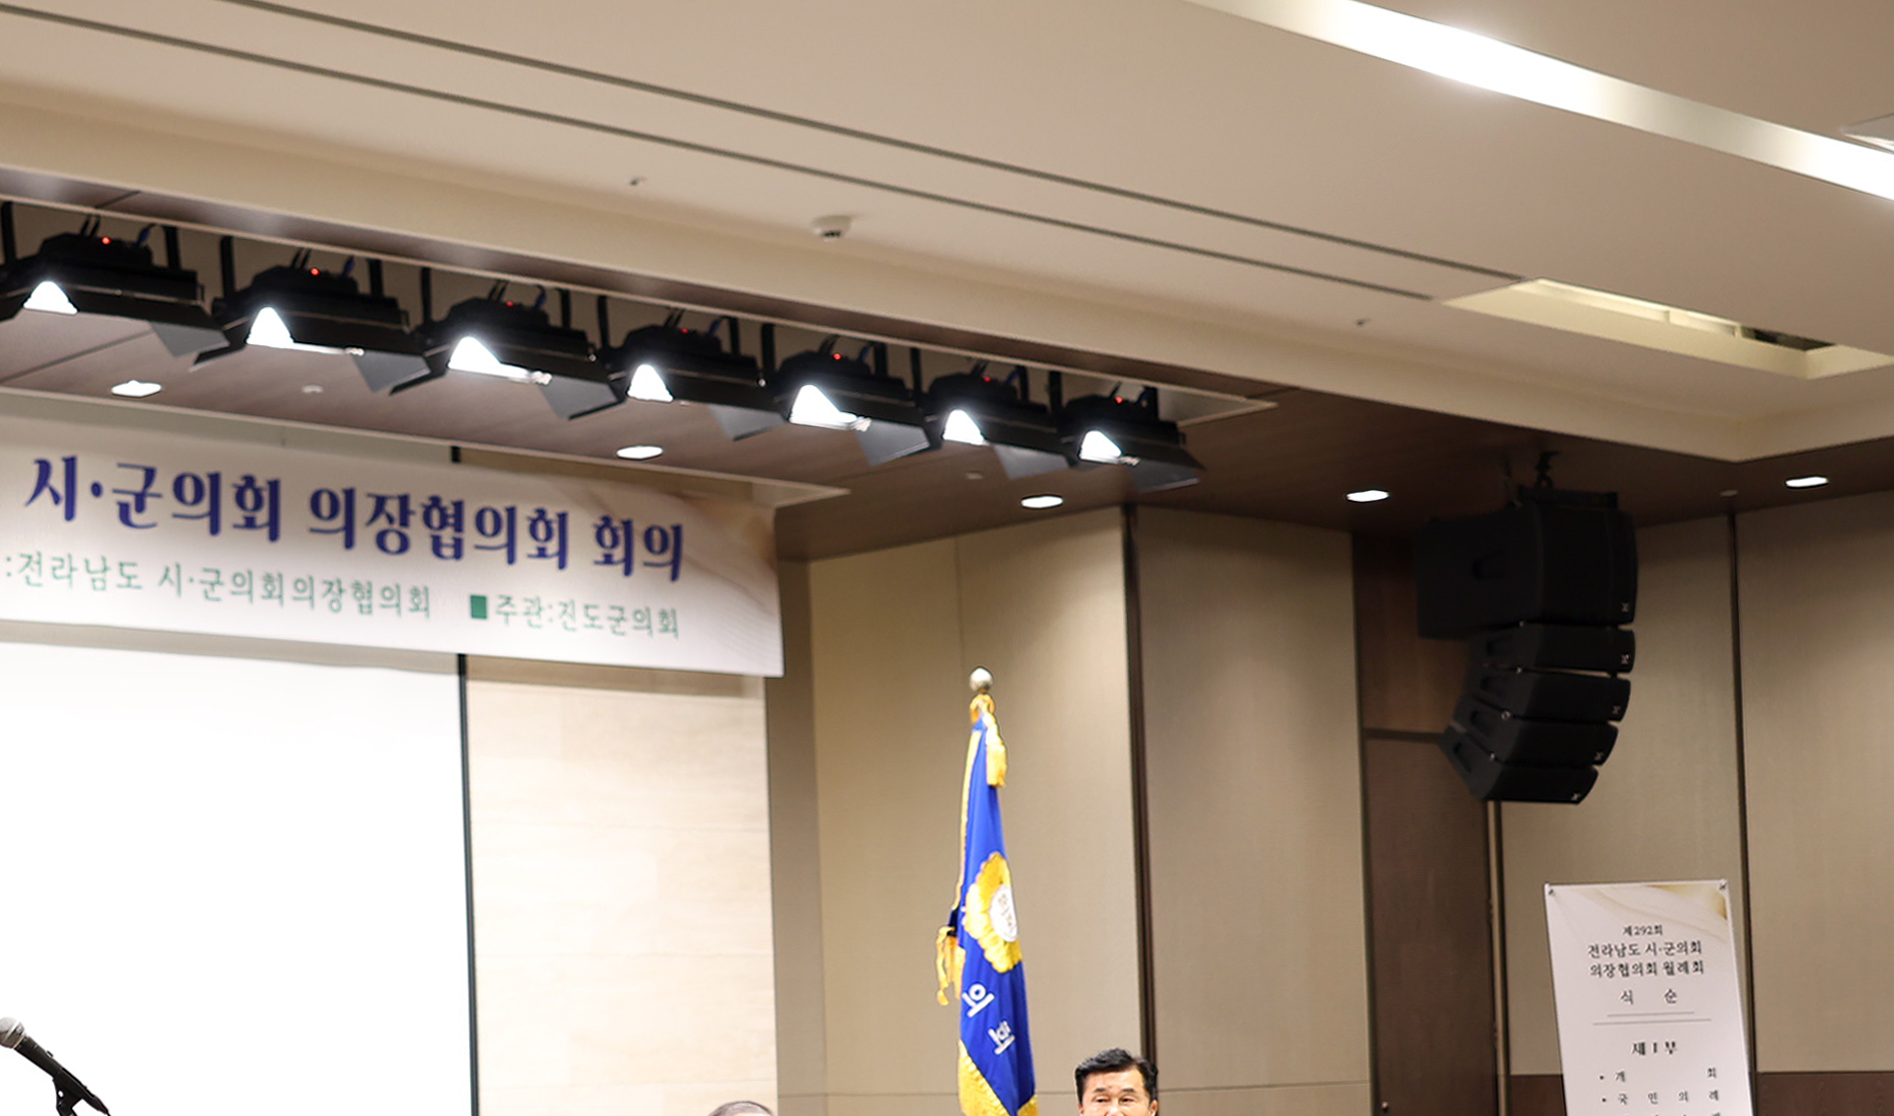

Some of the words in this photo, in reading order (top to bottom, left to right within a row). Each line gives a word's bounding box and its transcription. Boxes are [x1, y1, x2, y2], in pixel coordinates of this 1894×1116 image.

[25, 455, 281, 542] 시·군의회
[309, 487, 568, 570] 의장협의회
[593, 515, 683, 582] 회의
[1623, 924, 1663, 937] 제292회
[1588, 943, 1641, 959] 전라남도
[1590, 961, 1658, 979] 의장협의회
[1663, 960, 1704, 976] 월례회
